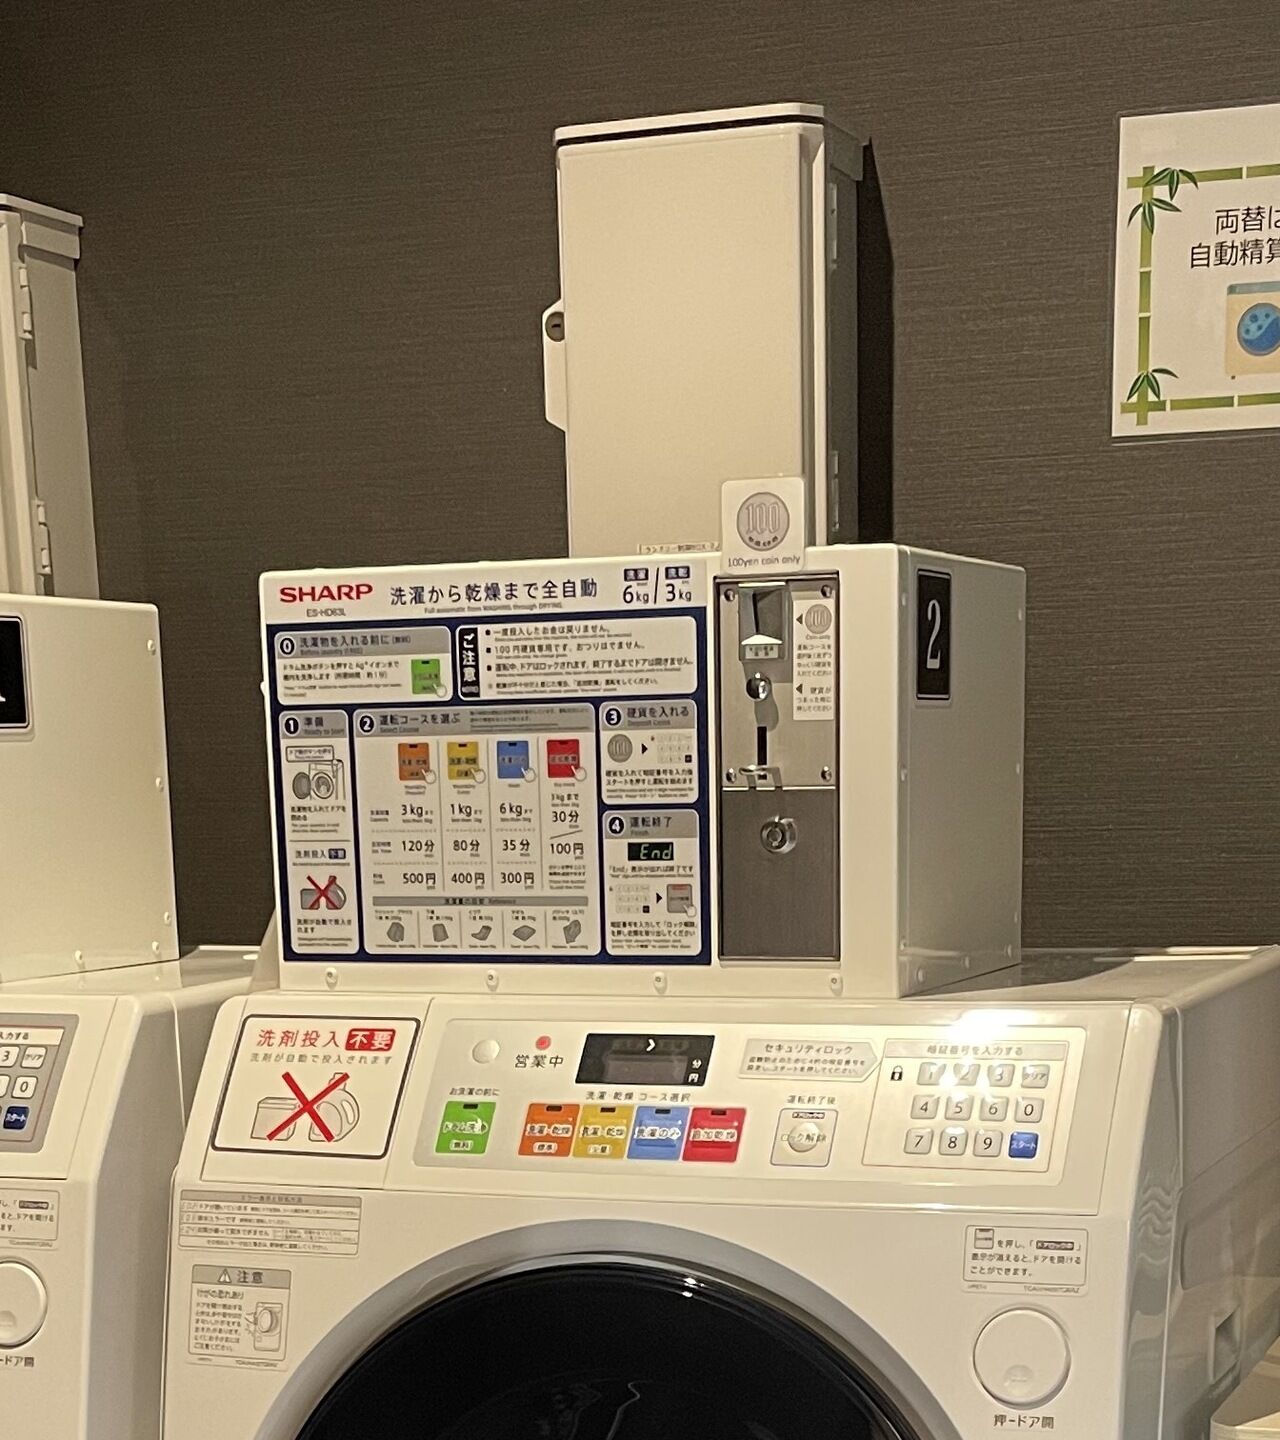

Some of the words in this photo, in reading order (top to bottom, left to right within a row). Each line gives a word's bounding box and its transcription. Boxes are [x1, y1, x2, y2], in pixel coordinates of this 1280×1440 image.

[745, 500, 780, 535] 100
[727, 557, 759, 569] 100yen
[761, 556, 780, 565] coin
[781, 554, 801, 566] only
[280, 583, 373, 604] SHARP
[390, 577, 598, 605] 洗濯から乾燥まで全自動
[493, 625, 611, 636] 一度投入したお金は戻りません。
[926, 600, 941, 669] 2
[300, 634, 389, 647] 洗濯物を入れる前に
[610, 711, 617, 723] 3
[626, 706, 689, 719] 硬貨を入れる
[362, 718, 372, 731] 2
[379, 713, 461, 726] 運転コースを選ぶ
[552, 810, 579, 823] 30分
[629, 816, 672, 829] 運転終了
[611, 818, 620, 832] 4
[401, 840, 434, 853] 120分
[453, 839, 480, 851] 80分
[502, 838, 530, 851] 35分
[549, 842, 584, 855] 100円
[640, 844, 671, 860] End
[402, 872, 436, 885] 500円
[451, 872, 485, 885] 400円
[500, 872, 534, 885] 300円
[256, 1029, 340, 1048] 洗剤投入
[348, 1031, 393, 1050] 不要
[765, 1043, 853, 1055] セキュリティロック
[927, 1044, 1023, 1057] 暗証番号を入力する
[2, 1051, 10, 1061] 3
[250, 1053, 393, 1065] 洗剤が自動で投入されます
[514, 1054, 564, 1069] 営業中
[960, 1069, 970, 1081] 2
[994, 1070, 1004, 1082] 3
[20, 1081, 29, 1092] 0
[449, 1087, 500, 1097] お洗濯の前に
[639, 1092, 691, 1102] コース選択
[786, 1095, 836, 1106] 運転終了後
[920, 1102, 929, 1114] 4
[954, 1103, 963, 1115] 5
[988, 1103, 998, 1116] 6
[1024, 1104, 1034, 1117] 0
[5, 1112, 27, 1123] スタート
[914, 1136, 923, 1148] 7
[947, 1136, 958, 1149] 8
[983, 1137, 993, 1150] 9
[1011, 1141, 1037, 1150] スタート
[237, 1270, 264, 1284] 注意
[970, 1266, 1032, 1277] ことができます。
